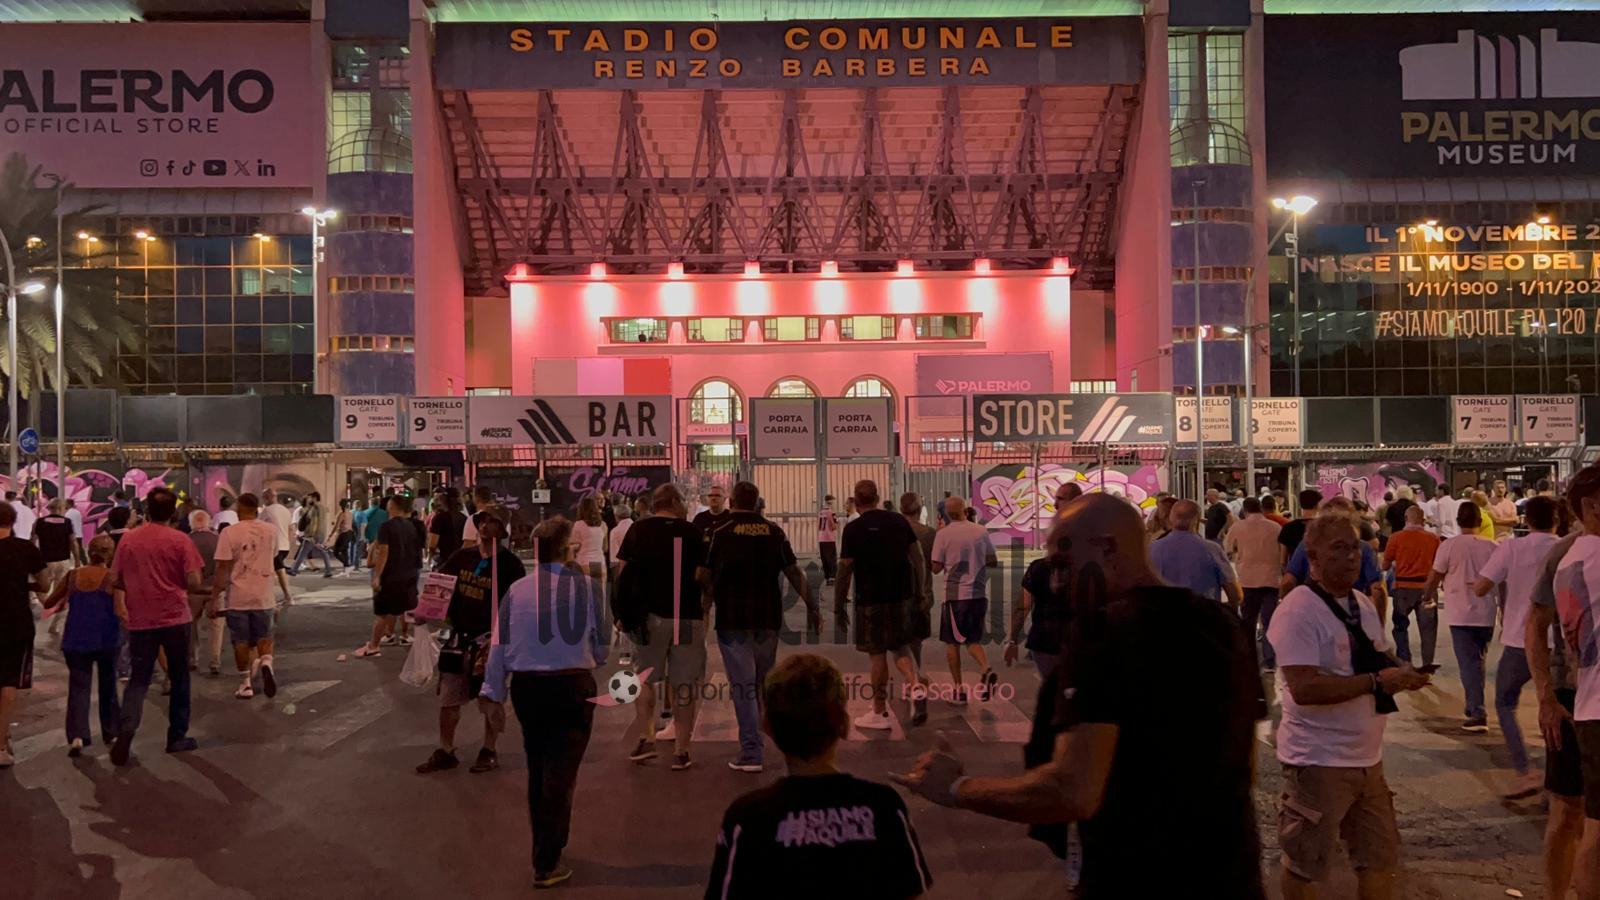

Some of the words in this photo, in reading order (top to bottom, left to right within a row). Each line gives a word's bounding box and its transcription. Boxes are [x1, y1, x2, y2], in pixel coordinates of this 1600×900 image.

[510, 28, 718, 51] STADIO
[784, 25, 1073, 50] COMUNALE
[594, 58, 741, 78] RENZO
[782, 57, 990, 77] BARBERA
[4, 118, 122, 134] OFFICIAL
[136, 118, 220, 133] STORE
[1400, 109, 1600, 143] PALERMO
[1438, 143, 1577, 165] MUSEUM
[1365, 226, 1389, 242] IL
[1424, 224, 1577, 242] NOVEMBRE
[1300, 255, 1391, 273] NASCE
[1400, 255, 1421, 272] IL
[1429, 254, 1525, 272] MUSEO
[1532, 253, 1584, 271] DEL
[1407, 281, 1498, 297] 1/11/1900
[1376, 309, 1515, 339] #SIAMOAQUILE
[1554, 308, 1586, 335] 120
[957, 380, 1031, 392] PALERMO
[344, 398, 394, 406] TORNELLO
[412, 401, 463, 409] TORNELLO
[1246, 401, 1298, 409] ORNELLO
[1457, 398, 1508, 406] TORNELLO
[1523, 397, 1574, 405] TORNELLO
[345, 414, 358, 429] 9
[414, 417, 427, 432] 9
[588, 401, 656, 437] BAR
[769, 415, 803, 423] PORTA
[838, 414, 872, 422] PORTA
[980, 400, 1074, 436] STORE
[1179, 416, 1192, 431] 8
[1460, 416, 1472, 430] 7
[1526, 415, 1538, 430] 7
[763, 426, 808, 434] CARRAIA
[833, 425, 878, 433] CARRAIA
[804, 823, 877, 847] AQUILE
